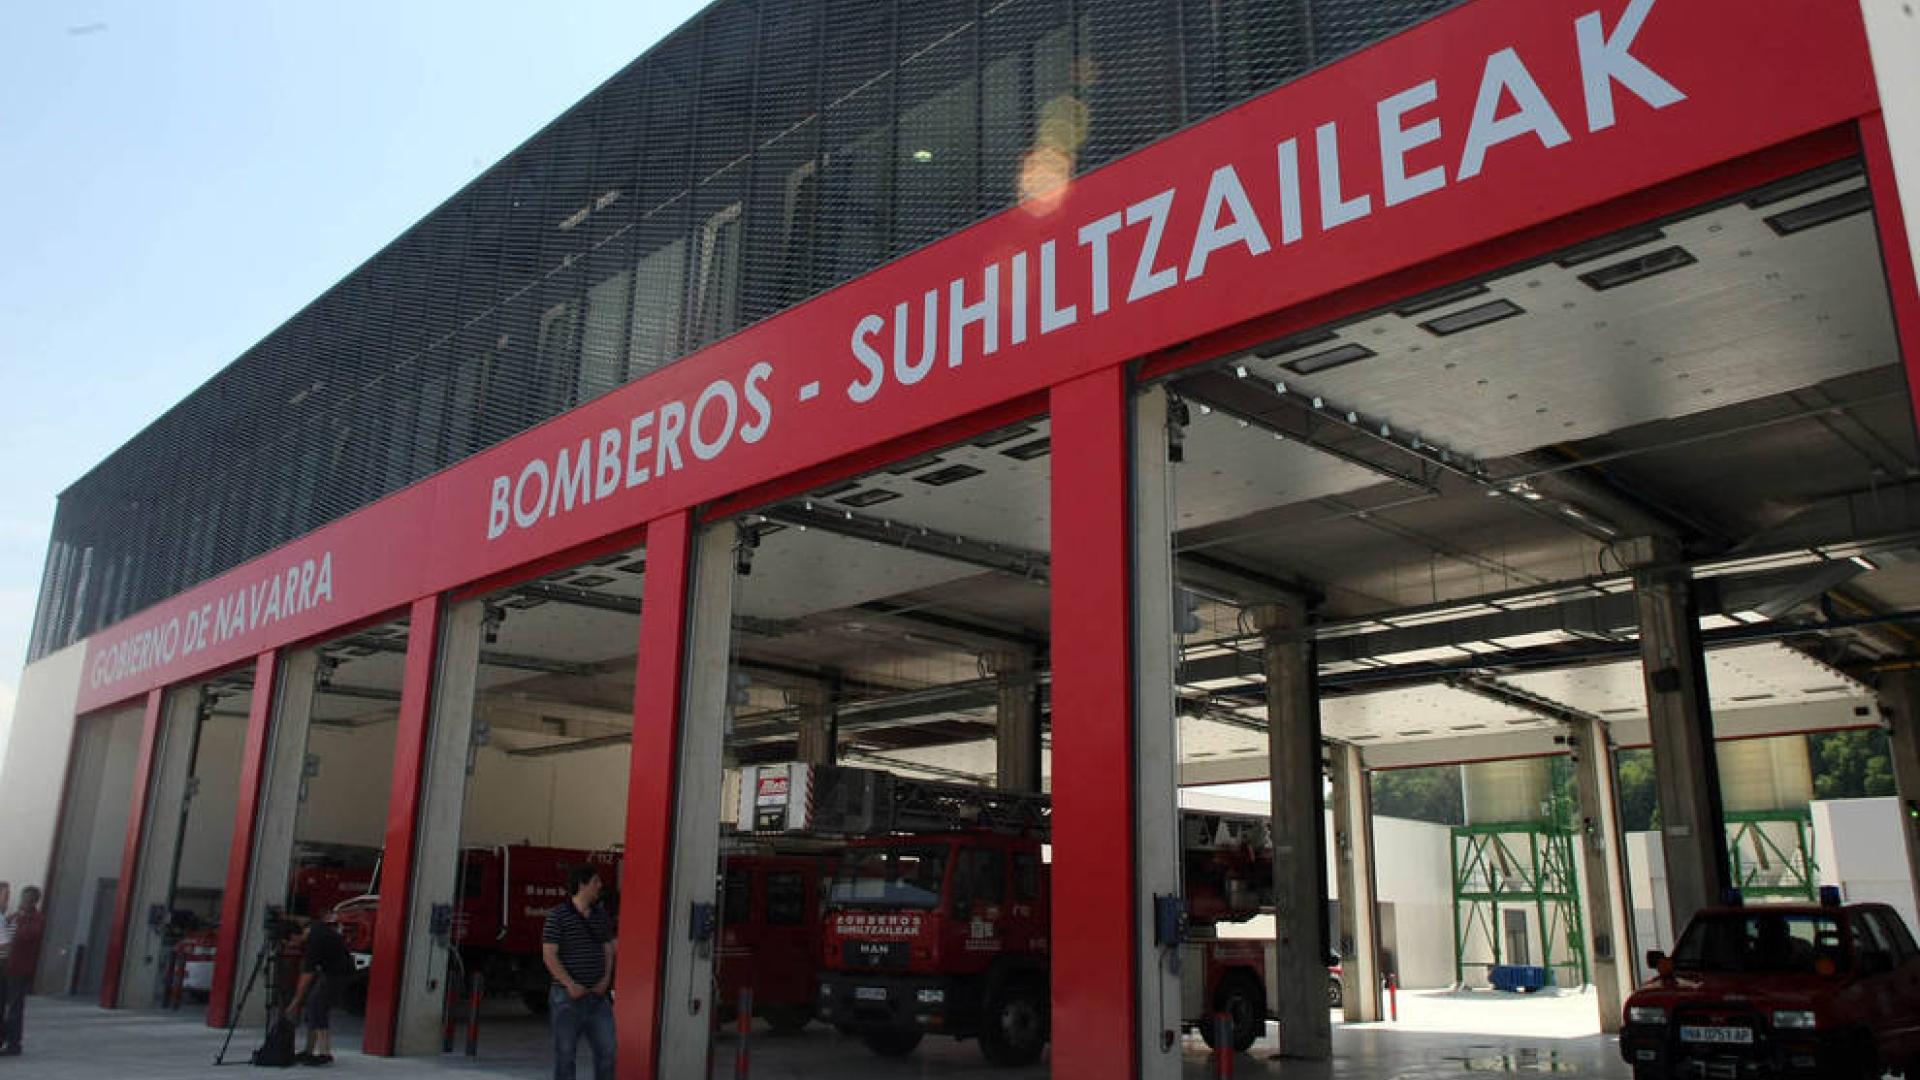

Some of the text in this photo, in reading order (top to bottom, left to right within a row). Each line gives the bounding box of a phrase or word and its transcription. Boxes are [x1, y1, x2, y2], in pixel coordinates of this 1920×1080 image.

[487, 0, 1688, 539] BOMBEROS - SUHILTZAILEAK
[91, 551, 333, 689] GOBIERNO DE NAVARRA
[860, 943, 889, 953] MAN
